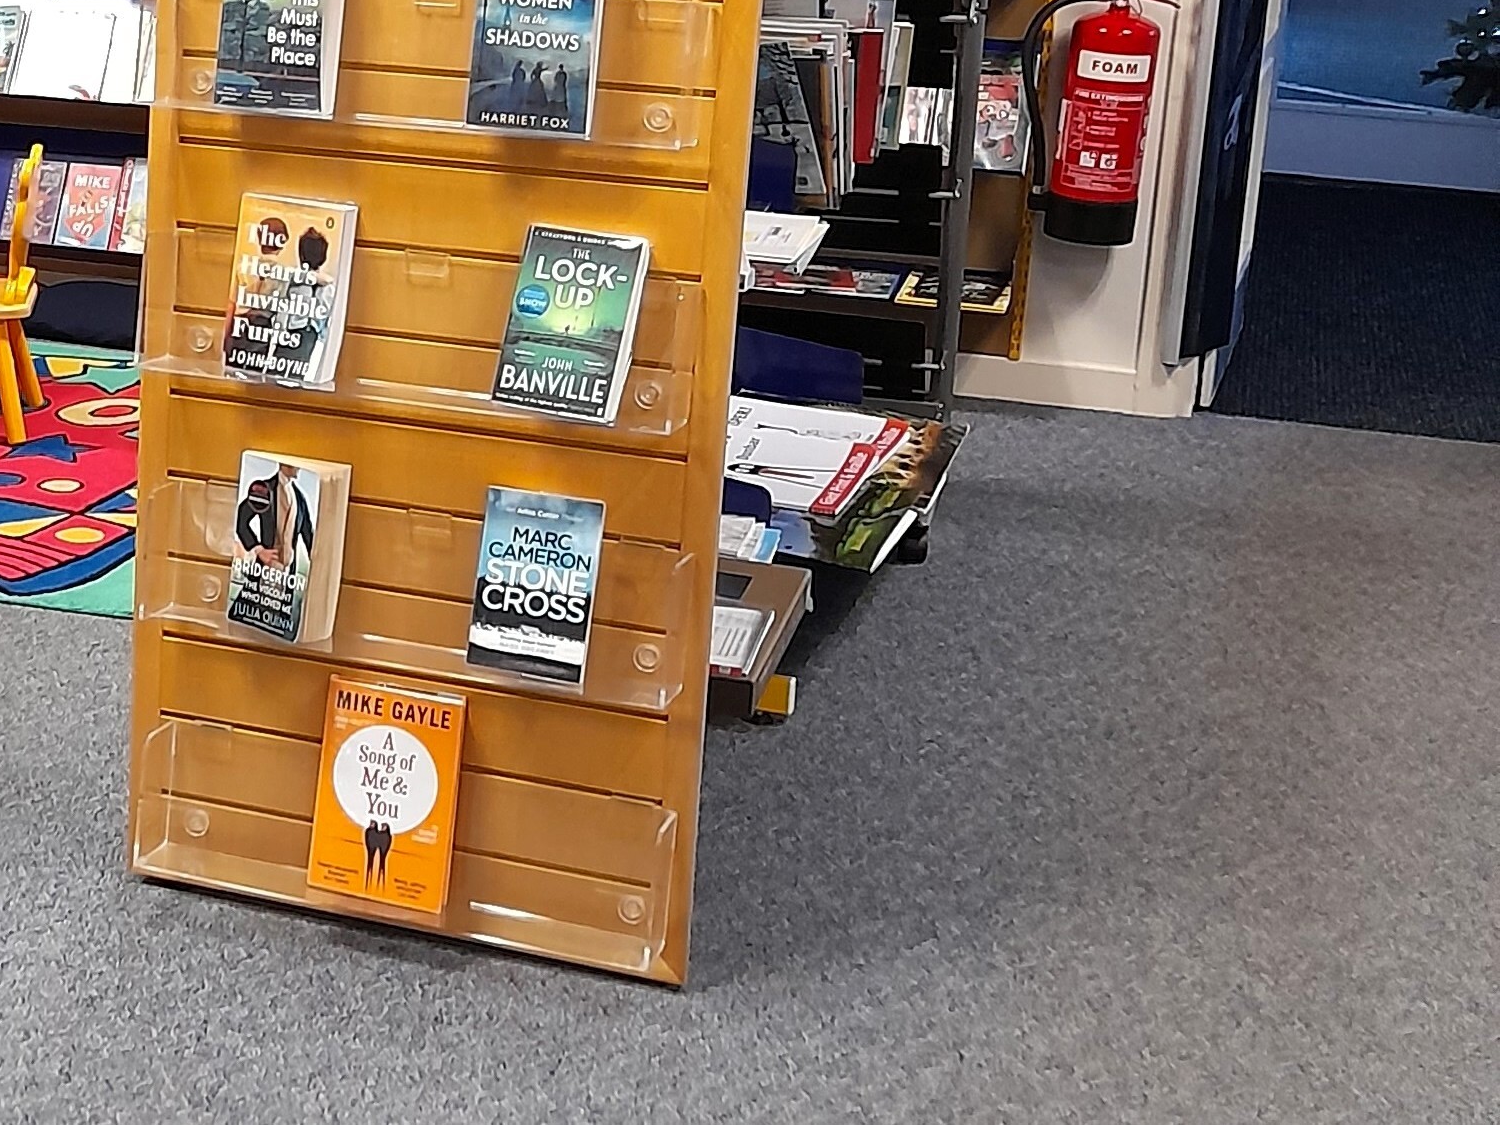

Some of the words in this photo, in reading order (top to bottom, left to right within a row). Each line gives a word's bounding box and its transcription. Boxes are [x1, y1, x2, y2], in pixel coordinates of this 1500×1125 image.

[280, 8, 318, 27] Must
[519, 13, 530, 24] in
[532, 13, 548, 26] the
[267, 26, 287, 44] Be
[290, 28, 316, 47] the
[486, 28, 580, 52] SHADOWS
[271, 47, 316, 67] Place
[1091, 60, 1139, 75] FOAM
[480, 112, 538, 127] HARRIET
[542, 115, 569, 129] FOX
[74, 174, 111, 189] MIKE
[69, 195, 111, 217] FALLS
[248, 222, 286, 248] The
[572, 248, 591, 261] THE
[240, 256, 318, 286] Heart's
[534, 255, 628, 290] LOCK-
[237, 285, 328, 319] Invisible
[554, 284, 594, 310] UP
[232, 317, 301, 349] Furies
[229, 349, 265, 368] JOHN
[541, 357, 573, 371] JOHN
[499, 364, 608, 404] BANVILLE
[513, 526, 573, 551] MARC
[489, 541, 592, 572] CAMERON
[234, 558, 306, 592] BRIDGERTON
[485, 559, 590, 599] STONE
[241, 591, 260, 603] WHO
[261, 596, 281, 611] LOVED
[481, 584, 586, 624] CROSS
[233, 602, 261, 621] JULIA
[263, 611, 294, 632] QUINN
[336, 690, 384, 717] MIKE
[392, 701, 451, 730] GAYLE
[382, 732, 395, 751] A
[358, 744, 397, 773] Song
[400, 754, 416, 772] of
[360, 766, 390, 791] Me
[393, 776, 408, 795] &
[366, 792, 399, 819] You
